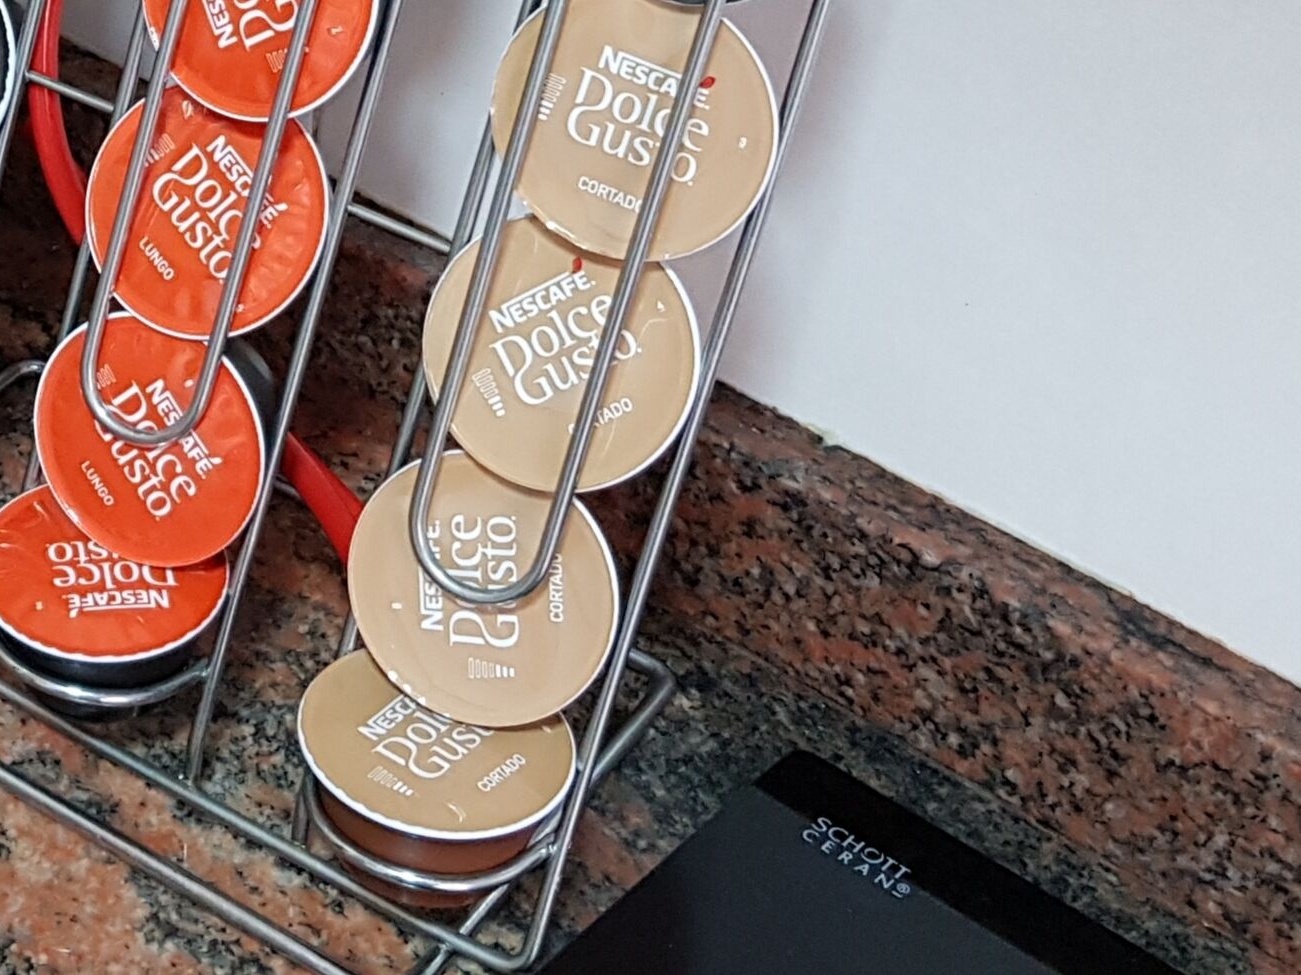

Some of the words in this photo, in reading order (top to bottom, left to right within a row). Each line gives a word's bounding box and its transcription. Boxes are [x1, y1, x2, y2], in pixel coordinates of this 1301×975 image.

[567, 106, 697, 185] Guso
[139, 236, 175, 281] LUNGO
[81, 460, 115, 506] LUNGO
[477, 754, 526, 792] CORTADO
[811, 817, 911, 880] SCHOTT
